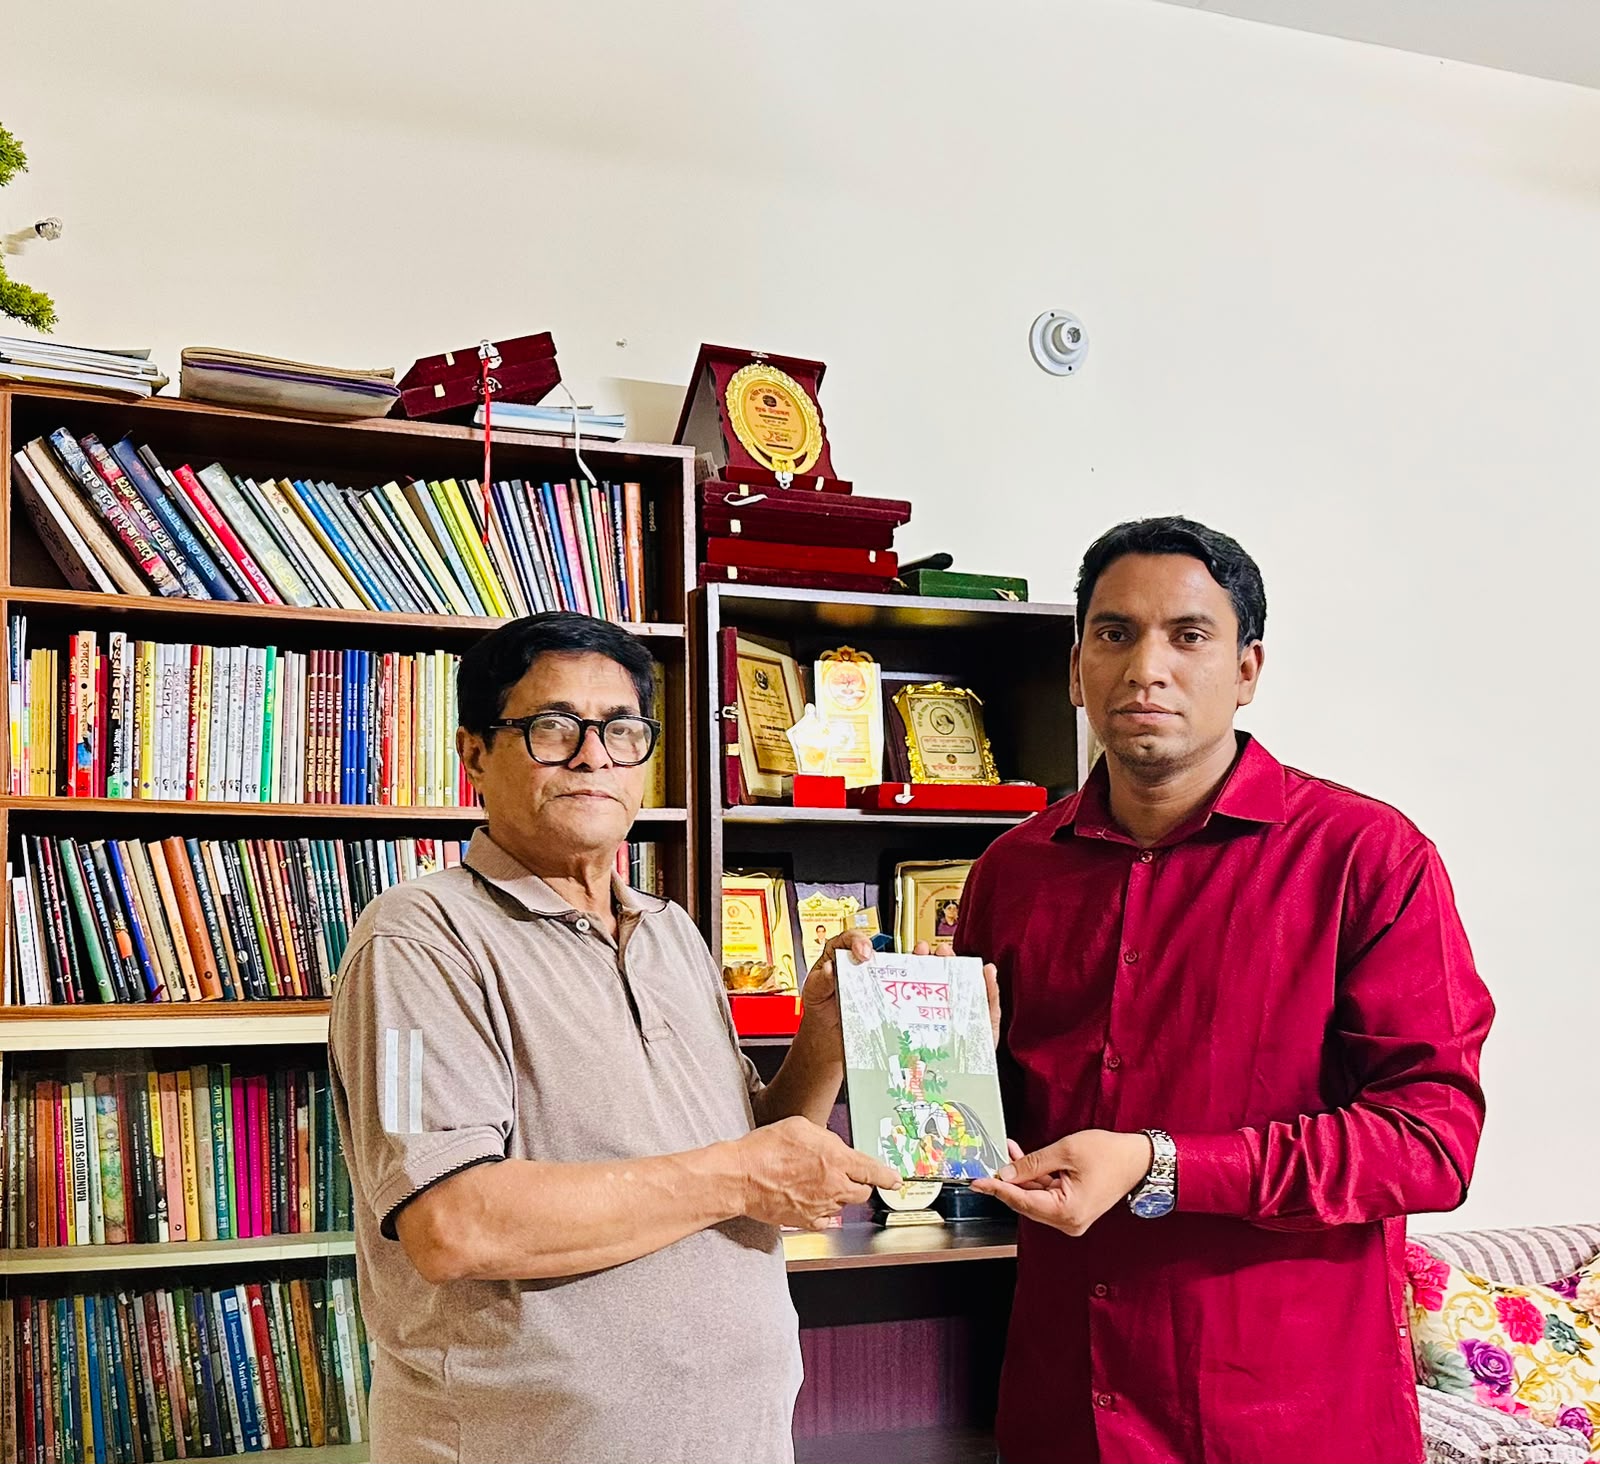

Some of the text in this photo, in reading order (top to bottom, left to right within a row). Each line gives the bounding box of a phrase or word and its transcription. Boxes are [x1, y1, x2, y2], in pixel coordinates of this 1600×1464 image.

[868, 965, 907, 979] মুকুলিত
[882, 980, 948, 1009] বৃক্ষের
[918, 1006, 952, 1021] ছায়া
[933, 1024, 947, 1034] হক
[73, 1116, 87, 1201] RAINDROPS OF LOVE
[230, 1321, 241, 1354] Introduction
[236, 1361, 249, 1389] Marine
